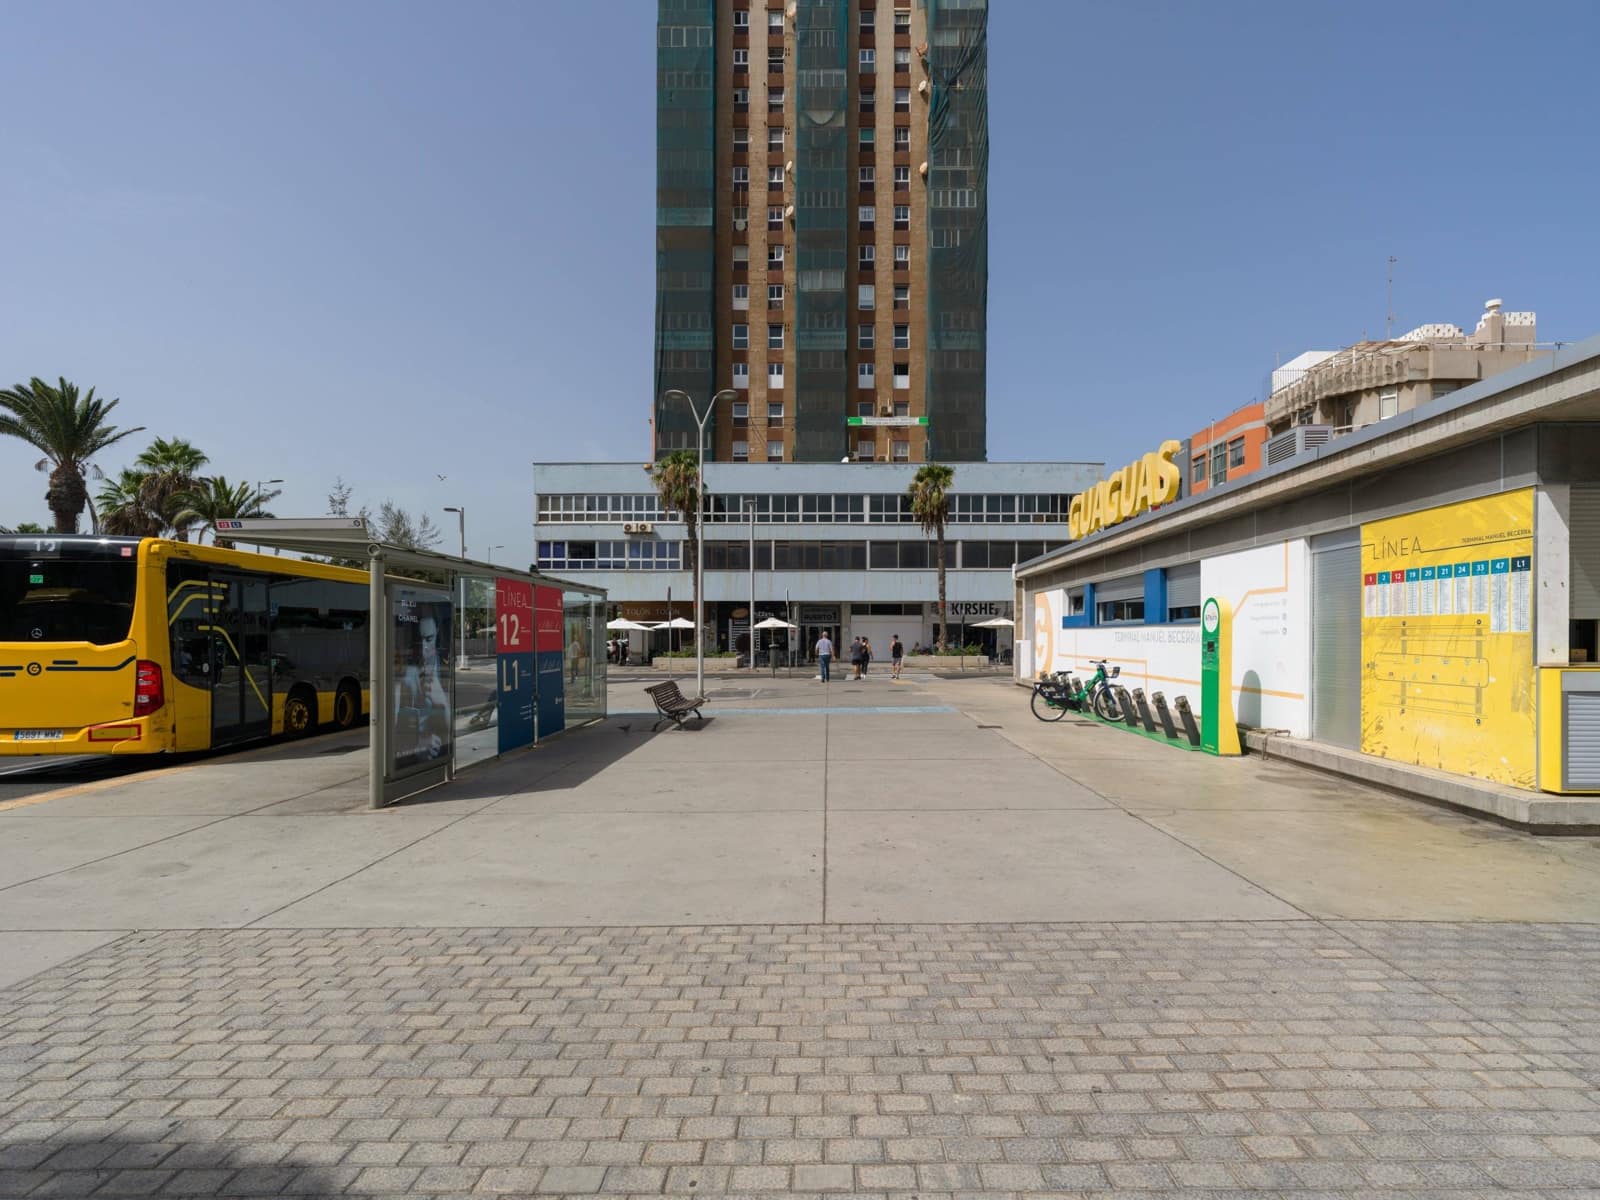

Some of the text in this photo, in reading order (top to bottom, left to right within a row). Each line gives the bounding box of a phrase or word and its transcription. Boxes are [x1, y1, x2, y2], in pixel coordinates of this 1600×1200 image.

[1069, 440, 1181, 540] GUAGUAS
[1373, 536, 1421, 560] LÍNEA
[503, 586, 527, 608] LÍNEA
[398, 614, 419, 623] CHANEL
[500, 614, 520, 646] 12
[503, 660, 518, 692] L1
